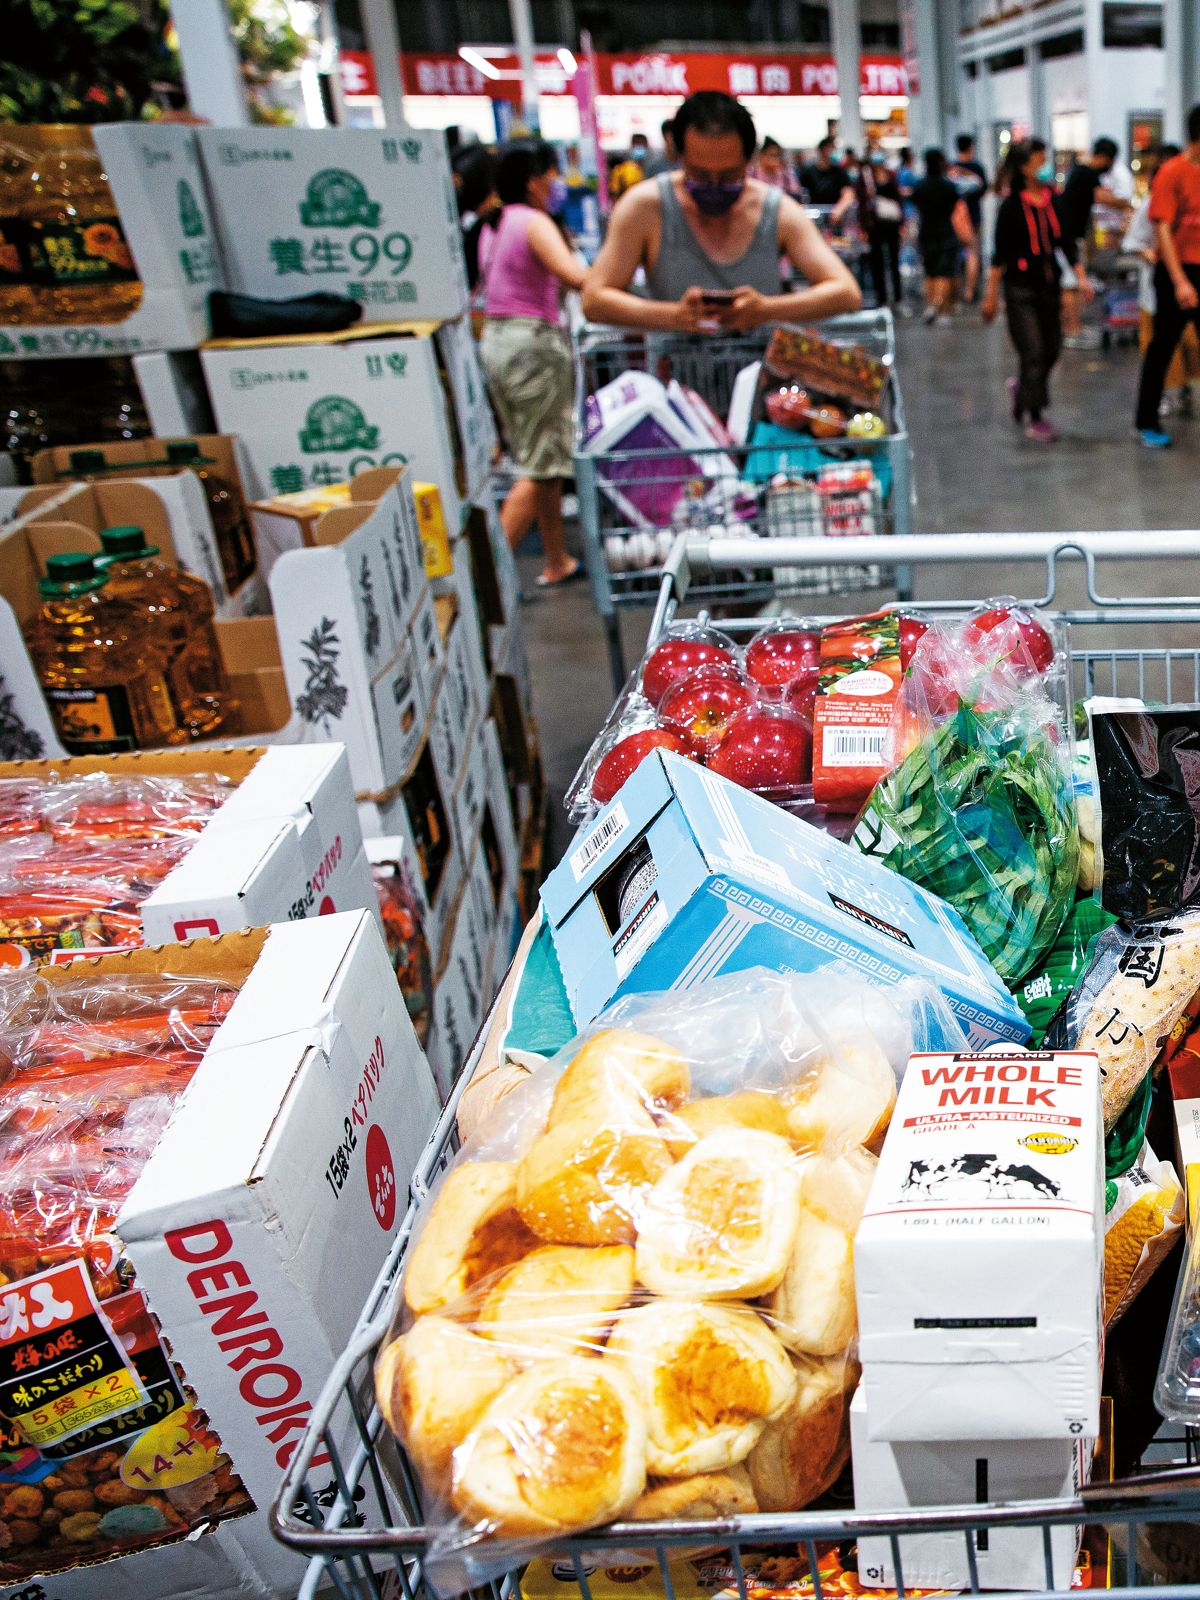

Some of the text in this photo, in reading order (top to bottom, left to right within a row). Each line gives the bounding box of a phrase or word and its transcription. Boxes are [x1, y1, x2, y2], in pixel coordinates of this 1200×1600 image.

[610, 62, 689, 93] PORK
[268, 231, 413, 277] 養生99
[614, 897, 658, 954] KIRKLAND
[834, 900, 911, 946] KIRKLAND
[351, 1035, 385, 1126] ペアパック
[921, 1065, 1083, 1086] WHOLE
[937, 1086, 1057, 1107] MILK
[912, 1124, 964, 1135] GRADE
[915, 1112, 1070, 1126] ULTRA-PASTEURIZED
[945, 1216, 986, 1227] (HALF
[991, 1216, 1051, 1226] GALLON)
[164, 1219, 332, 1471] DENROKU
[12, 1354, 103, 1408] 味のこだわり
